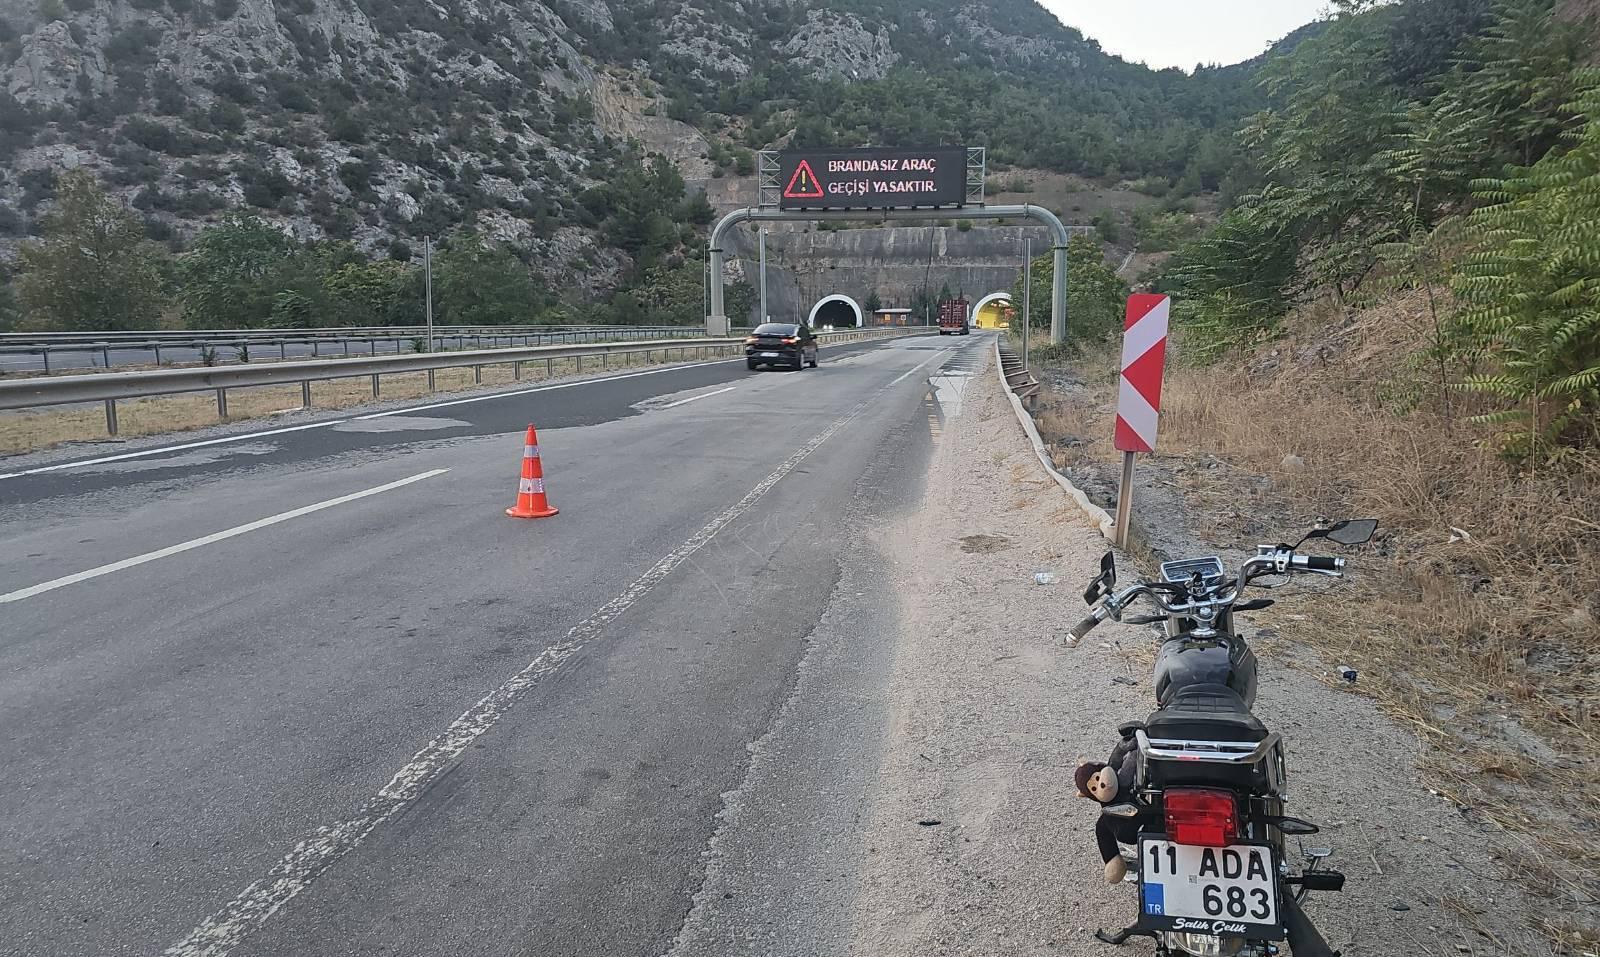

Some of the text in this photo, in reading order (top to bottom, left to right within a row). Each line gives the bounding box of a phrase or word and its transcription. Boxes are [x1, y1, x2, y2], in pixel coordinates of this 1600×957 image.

[828, 158, 936, 173] BRANDASIZ ARAÇ
[828, 179, 937, 196] GEÇİŞİ YASAKTIR.
[1149, 845, 1268, 881] 11 ADA
[1147, 903, 1162, 914] TR
[1202, 884, 1271, 920] 683
